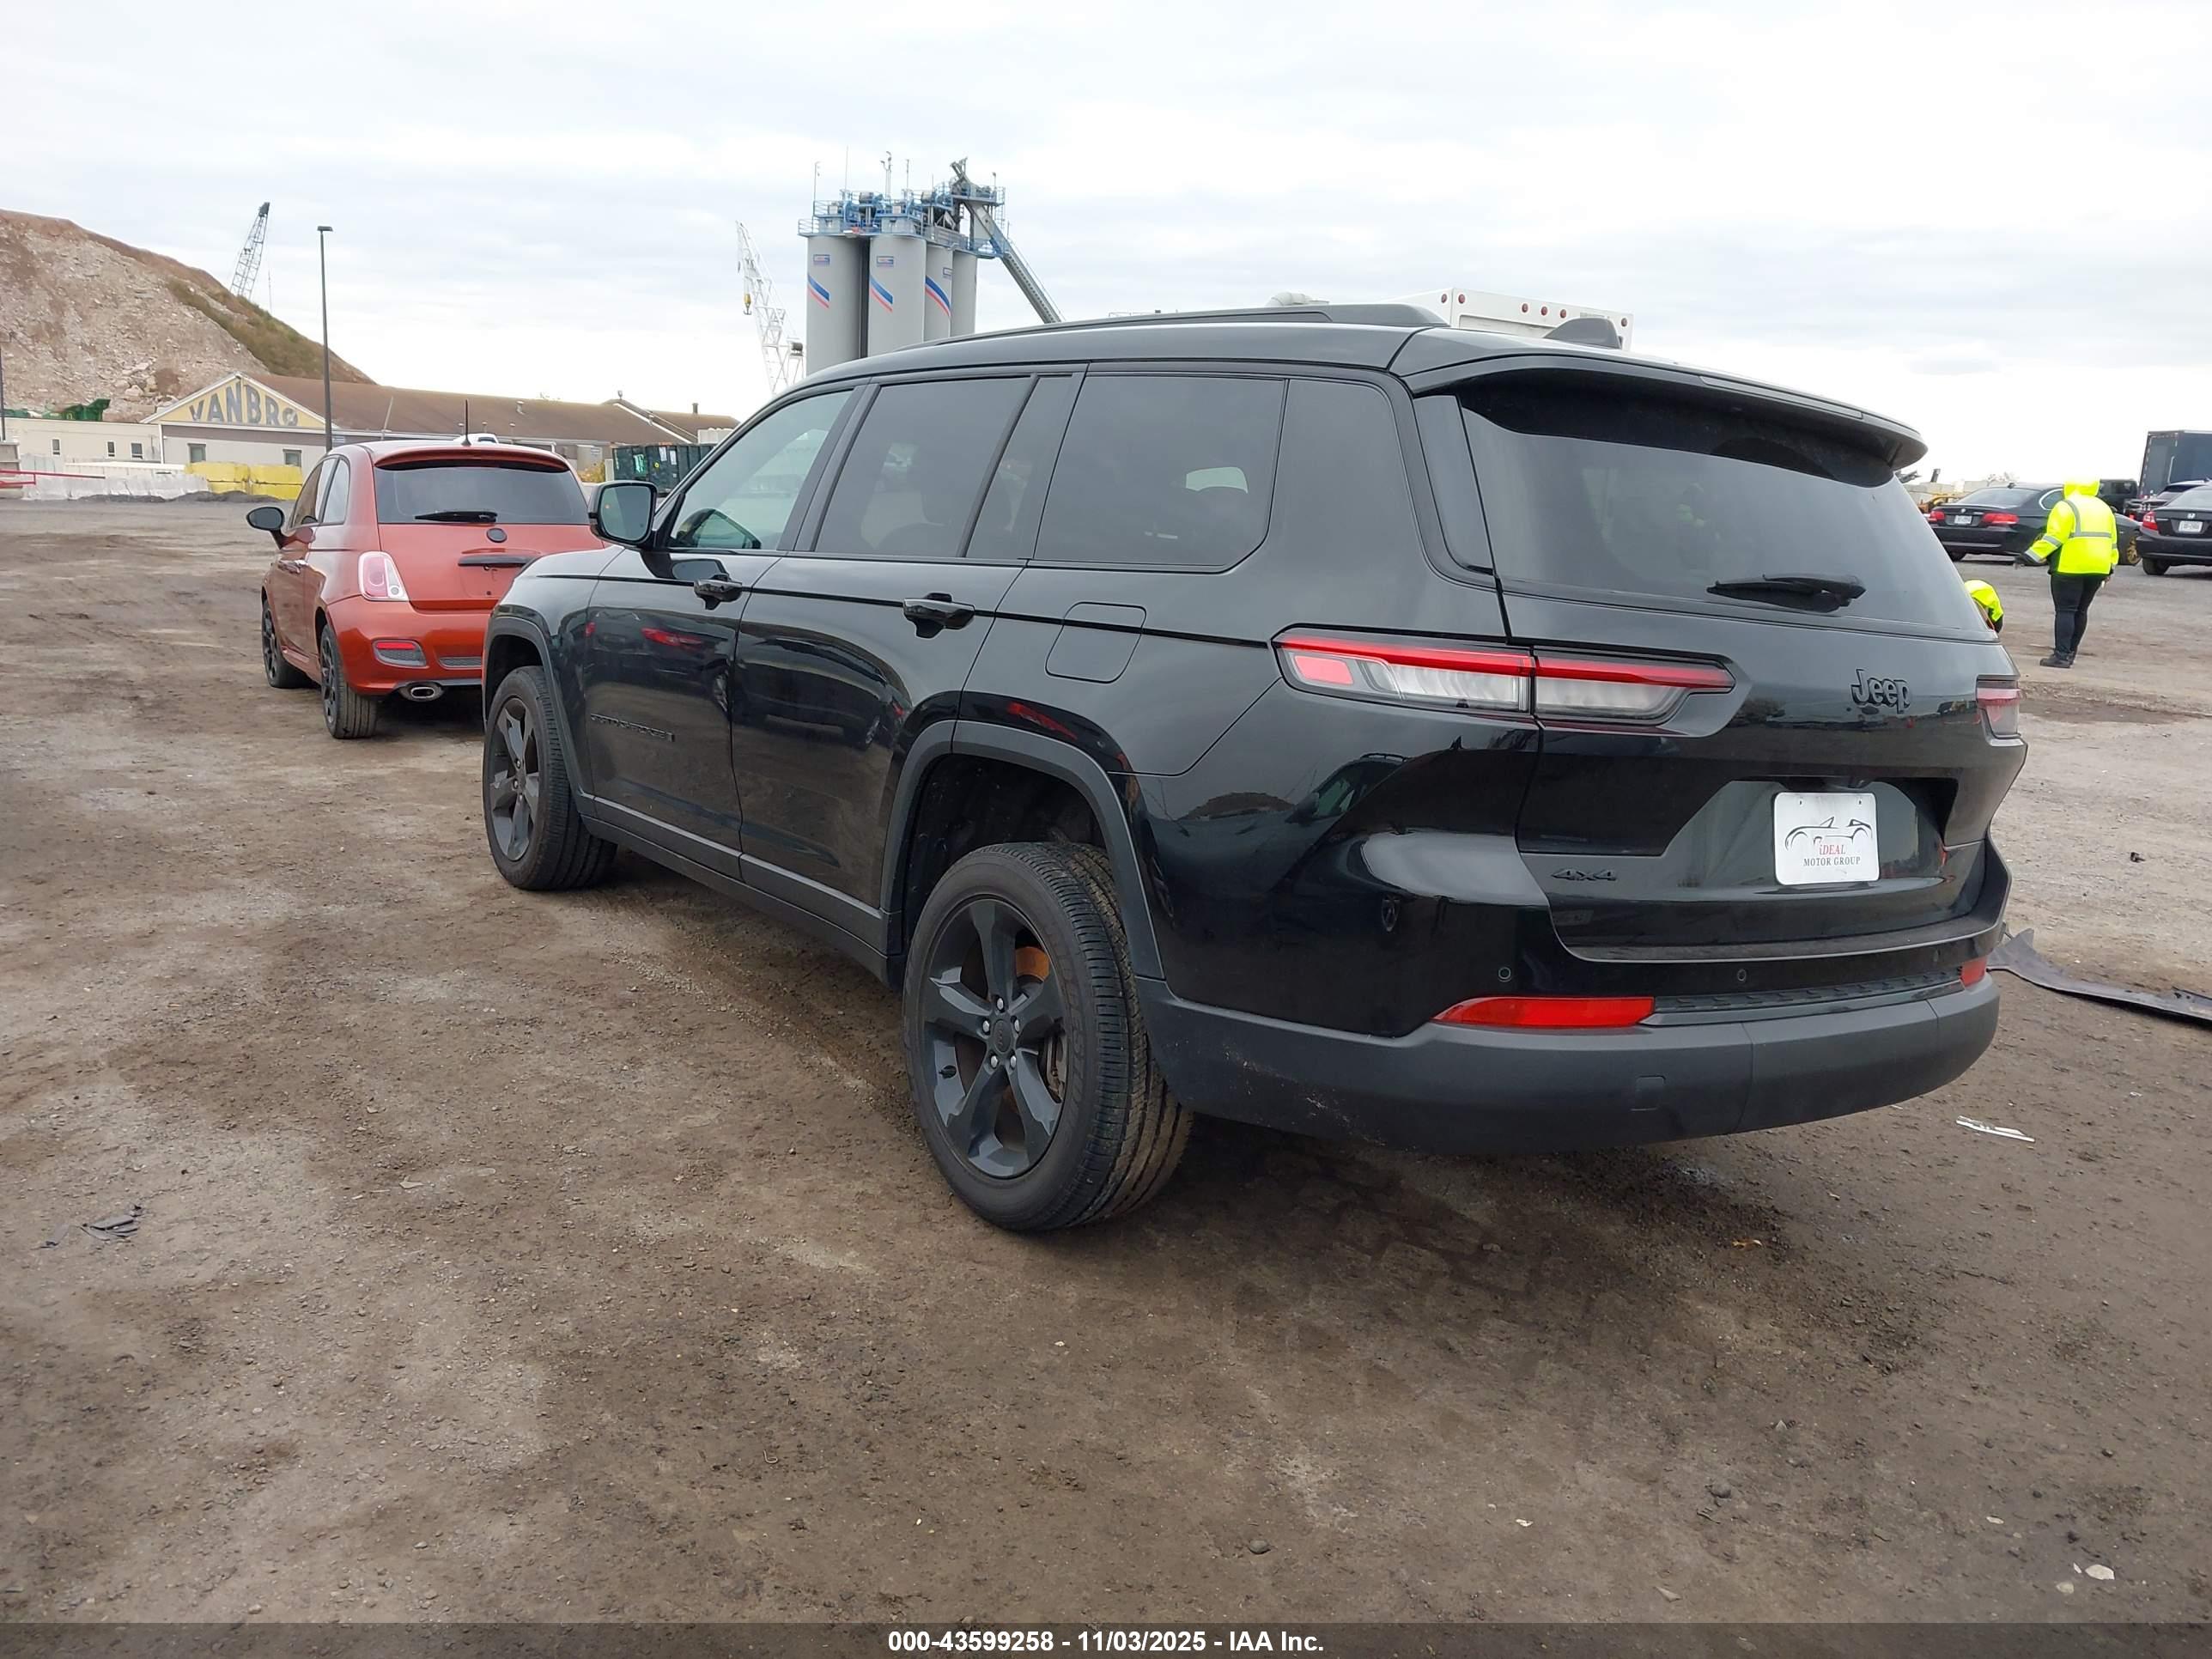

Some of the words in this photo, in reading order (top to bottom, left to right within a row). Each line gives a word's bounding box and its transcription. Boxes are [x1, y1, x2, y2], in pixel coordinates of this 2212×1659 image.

[189, 380, 298, 426] VANBRO
[1850, 668, 1911, 714] Jeep
[1803, 857, 1832, 866] MOTOR
[1833, 857, 1861, 866] GROUP
